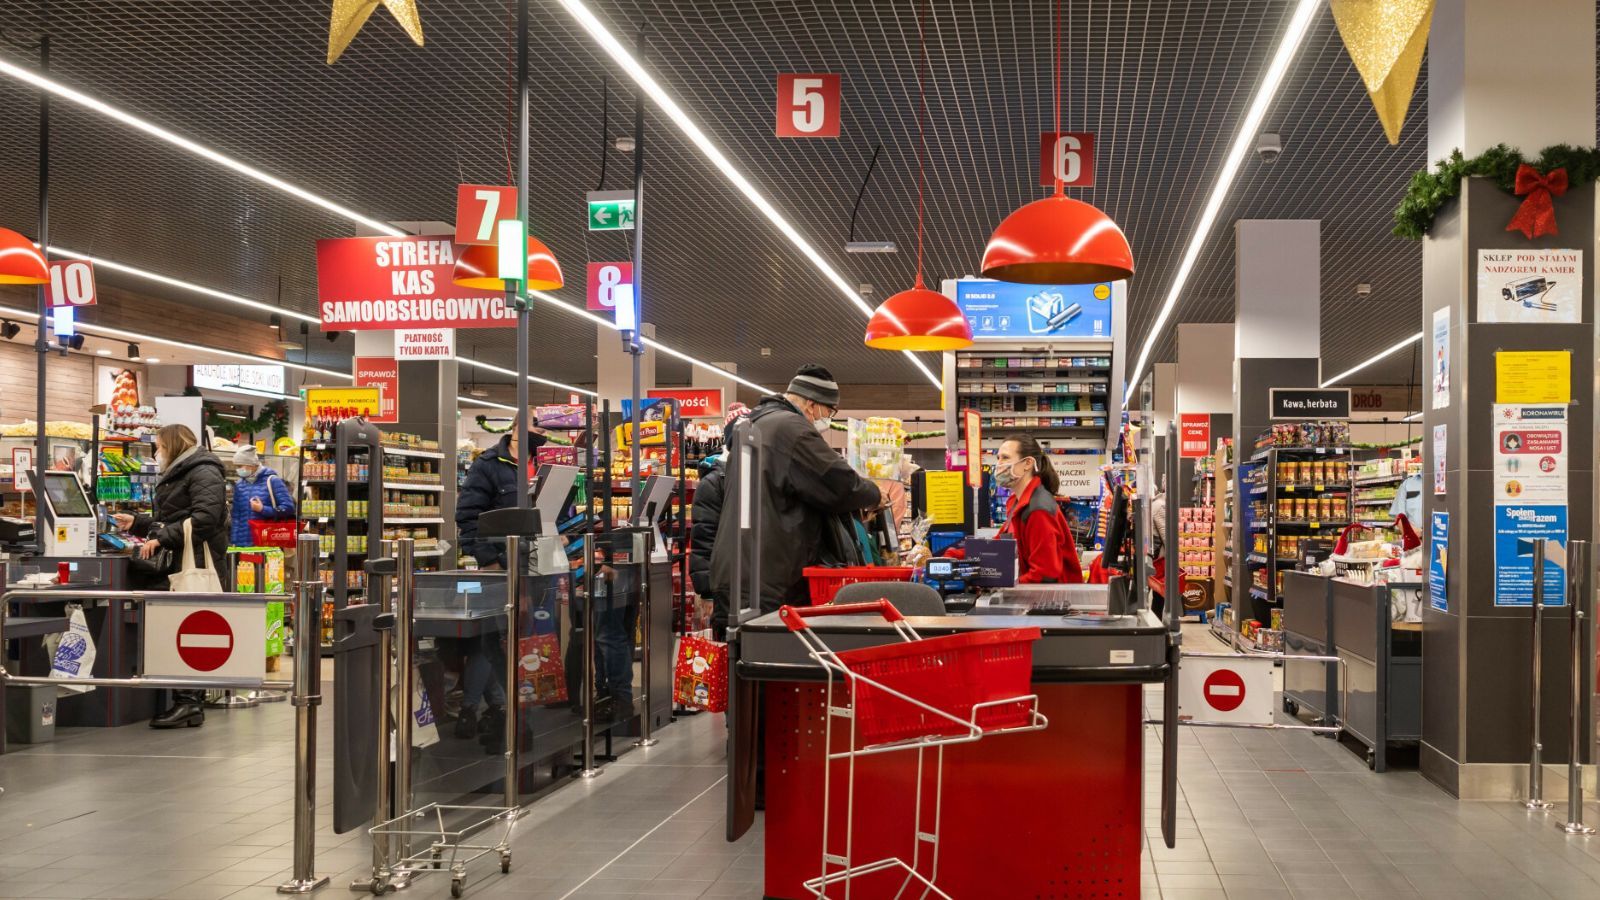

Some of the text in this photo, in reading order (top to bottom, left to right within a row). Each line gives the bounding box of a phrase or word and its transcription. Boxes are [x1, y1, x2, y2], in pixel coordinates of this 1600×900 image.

[792, 78, 825, 132] 5
[1053, 136, 1081, 182] 6
[475, 190, 501, 240] 7
[375, 240, 455, 267] STREFA
[1483, 254, 1512, 262] SKLEP
[1516, 254, 1535, 262] POD
[1541, 266, 1576, 274] KAMER
[49, 263, 94, 305] 10
[391, 270, 435, 295] KAS
[598, 265, 622, 307] 8
[322, 298, 518, 323] SAMOOBSŁUGOWYCH
[404, 332, 443, 343] PŁATNOŚĆ
[399, 346, 423, 356] TYLKO
[358, 369, 397, 378] SPRAWDŹ
[679, 396, 709, 407] wości
[1283, 399, 1338, 409] Kawa, herbata
[1352, 389, 1382, 408] DRÓB
[1060, 479, 1091, 487] CZTOWE
